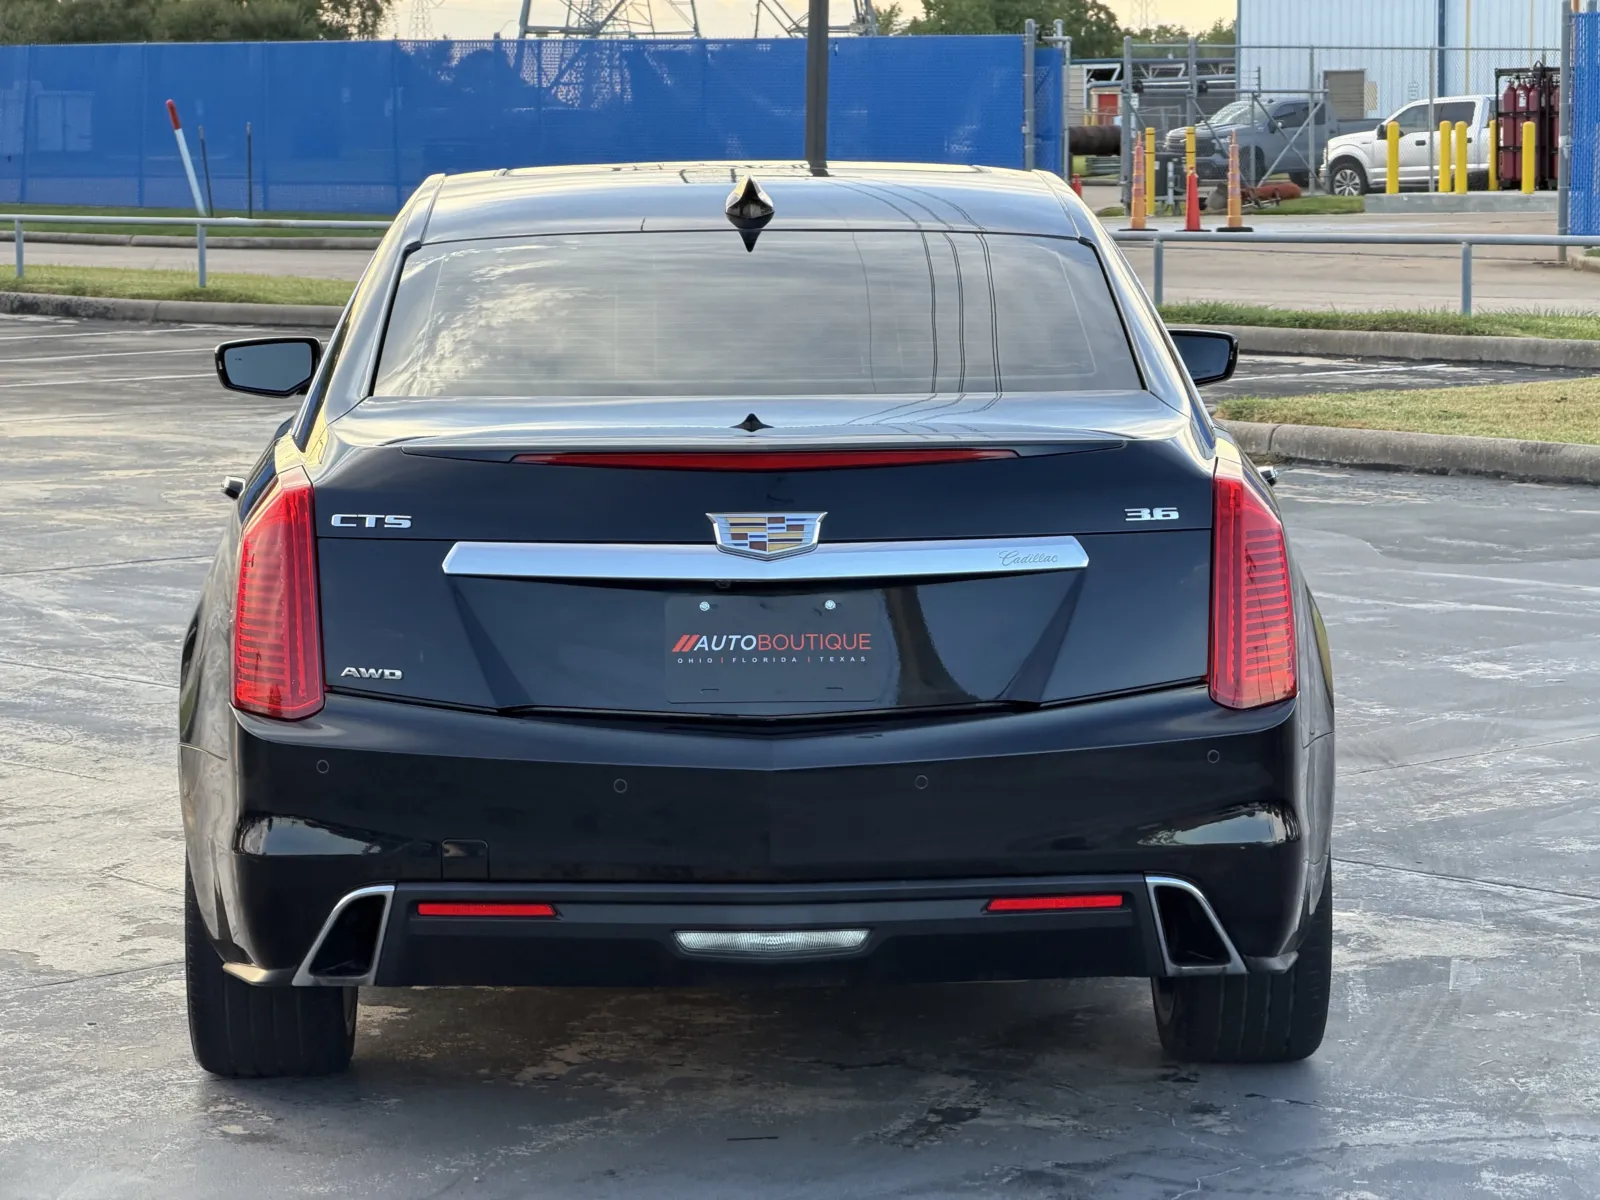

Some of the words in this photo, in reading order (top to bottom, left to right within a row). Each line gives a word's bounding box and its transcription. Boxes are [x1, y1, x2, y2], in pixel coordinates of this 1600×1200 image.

[331, 513, 412, 529] CTS
[998, 549, 1059, 567] Cadillac
[693, 633, 872, 652] AUTOBOUTIQUE
[340, 666, 403, 680] AWD
